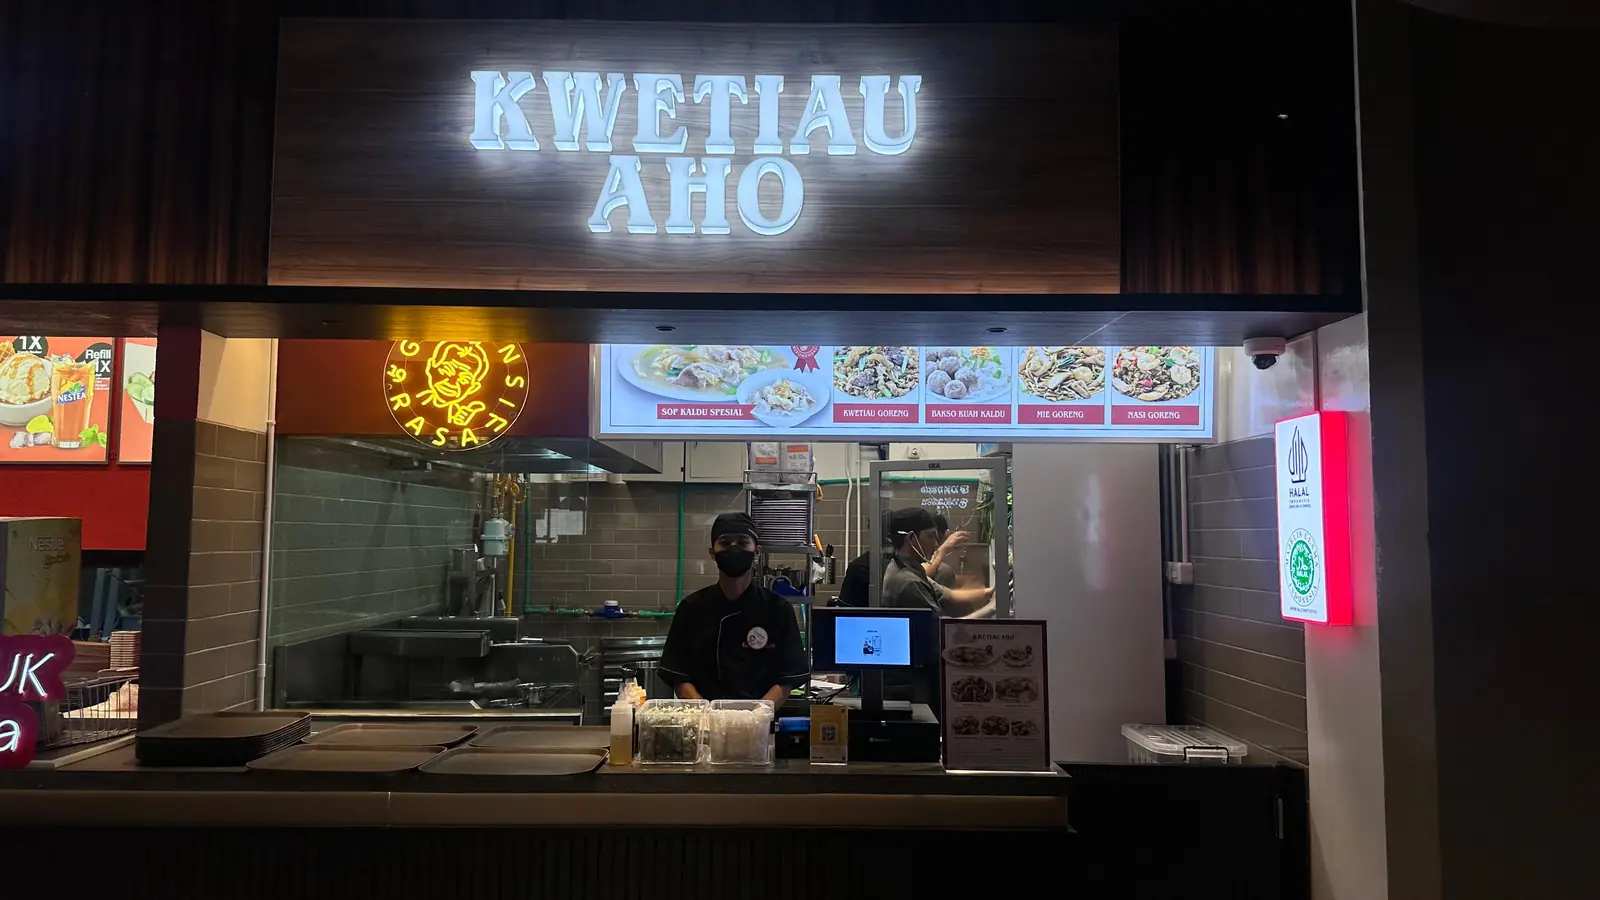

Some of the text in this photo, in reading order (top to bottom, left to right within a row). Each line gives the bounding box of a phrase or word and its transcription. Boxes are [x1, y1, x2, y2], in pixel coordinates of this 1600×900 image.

[470, 71, 922, 155] KWETIAU
[588, 155, 804, 235] AHO
[85, 349, 112, 359] Refill
[57, 392, 87, 403] NESTEA
[661, 408, 744, 417] SOP KALDU SPESIAL
[843, 409, 909, 418] KWETIAU GORENG
[931, 410, 1006, 418] BAKSO KUAH KALDU
[1036, 410, 1084, 419] MIE GORENG
[1127, 411, 1180, 419] NASI GORENG
[1289, 487, 1309, 498] HALAL
